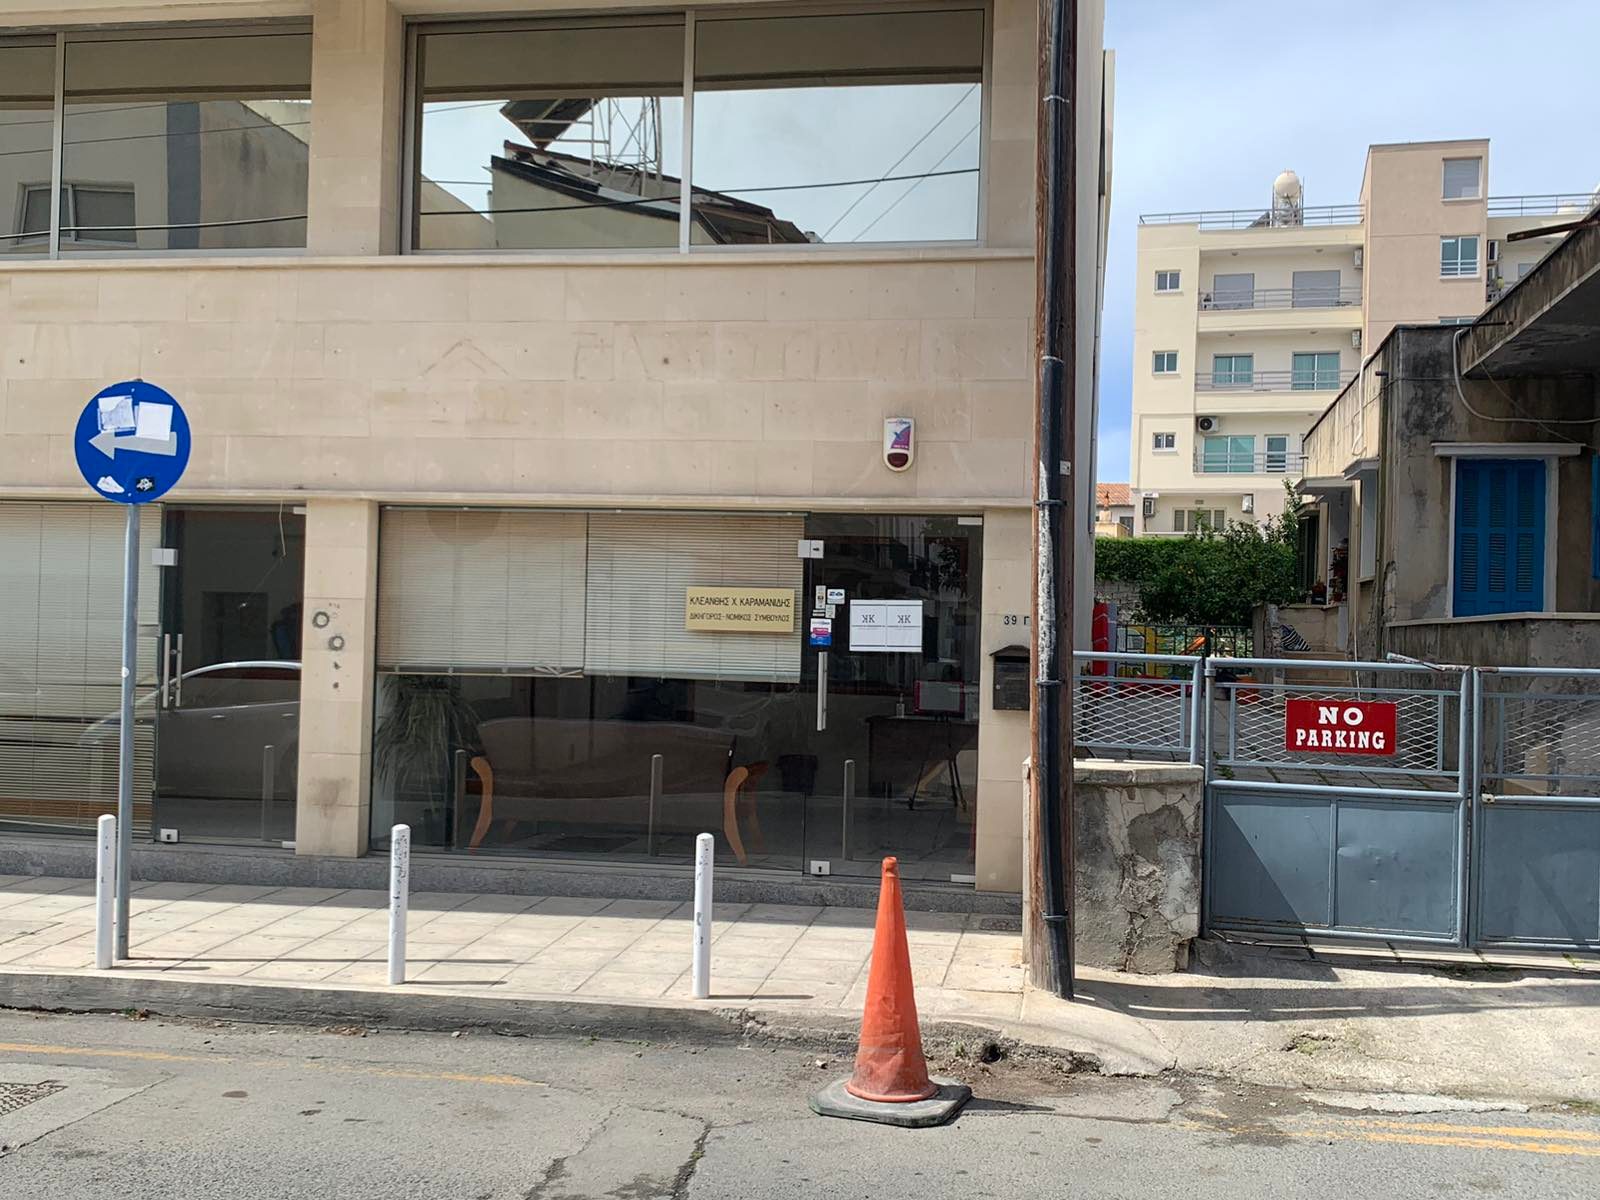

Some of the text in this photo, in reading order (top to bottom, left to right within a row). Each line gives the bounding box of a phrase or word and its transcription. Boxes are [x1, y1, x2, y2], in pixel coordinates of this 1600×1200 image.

[689, 596, 730, 606] ΚΛΕΑΝΘΗΣ
[739, 597, 791, 608] ΚΑΡΑΜΑΝΙΔΗΣ
[754, 613, 790, 622] ΣΥΜΒΟΥΛΟΣ
[1004, 615, 1017, 625] 39
[1318, 706, 1364, 726] NO
[1295, 728, 1386, 750] PARKING
